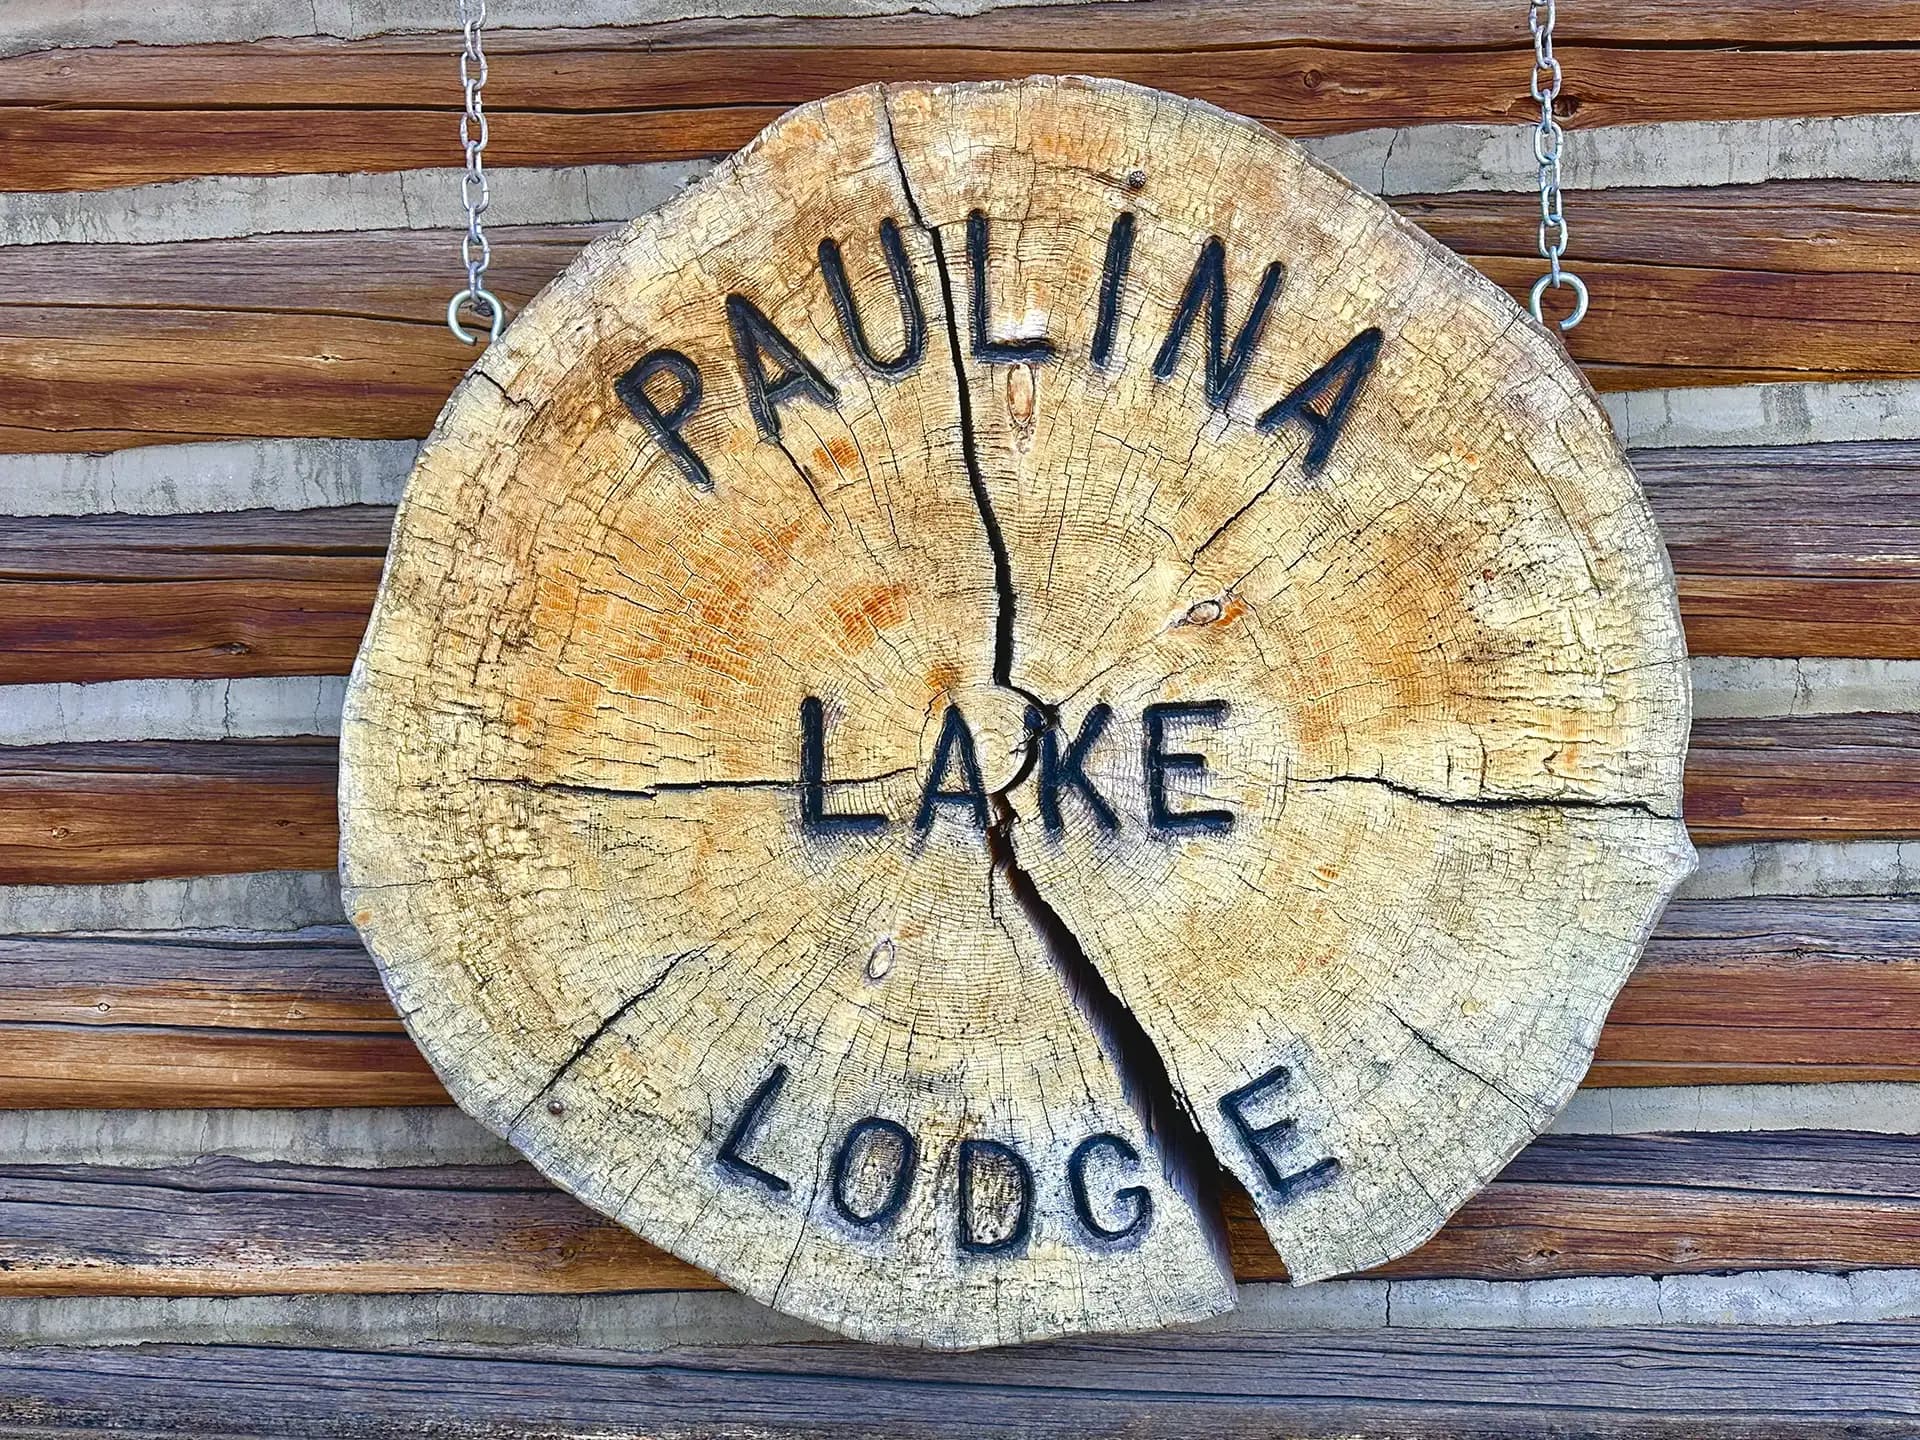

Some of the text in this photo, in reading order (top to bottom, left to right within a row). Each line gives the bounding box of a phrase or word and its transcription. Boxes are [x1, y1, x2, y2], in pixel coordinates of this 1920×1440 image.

[616, 209, 1383, 489] PAULINA
[800, 695, 1236, 840] LAKE
[716, 1065, 1340, 1254] LODGE
